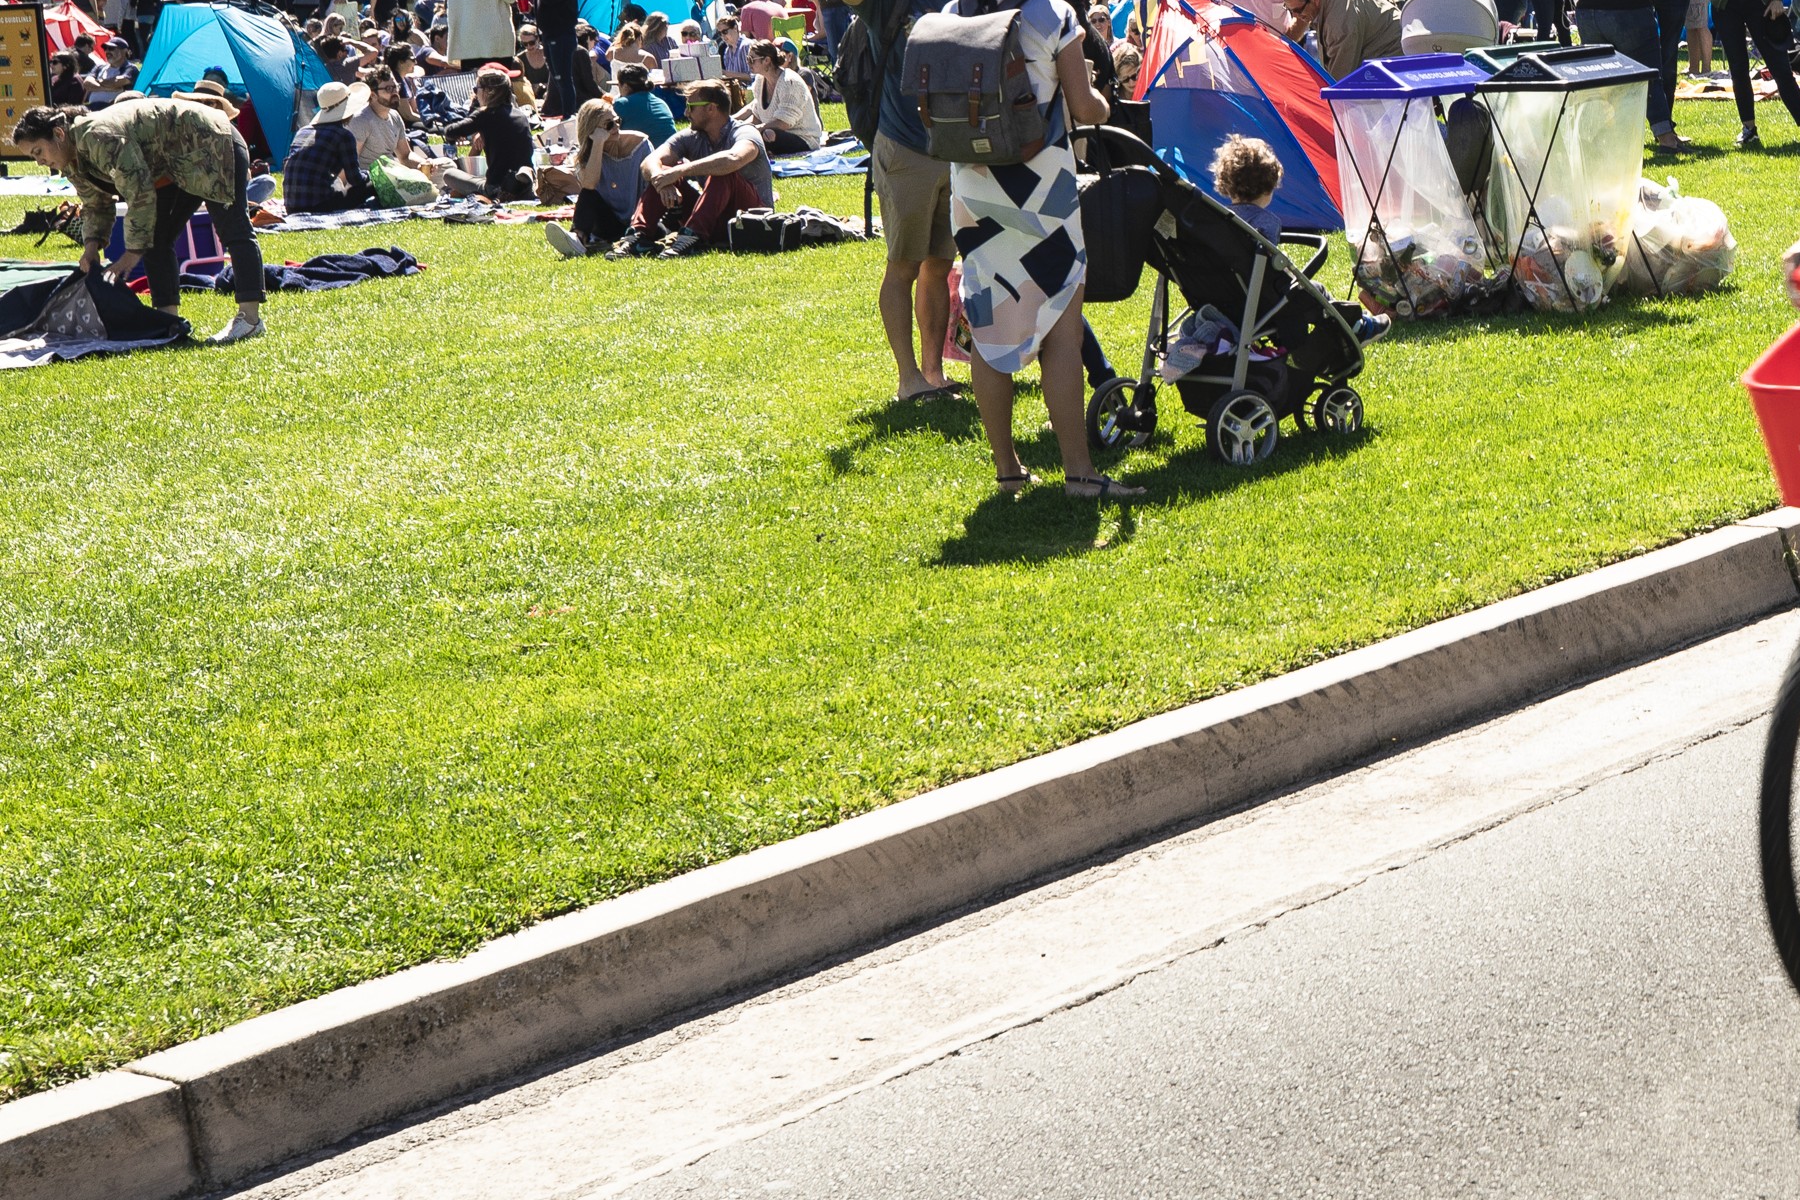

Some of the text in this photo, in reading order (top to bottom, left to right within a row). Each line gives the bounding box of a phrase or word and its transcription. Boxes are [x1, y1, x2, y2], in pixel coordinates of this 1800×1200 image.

[5, 15, 32, 23] GUIDELINES
[1576, 64, 1602, 73] TRASH
[1601, 61, 1623, 70] ONLY
[1418, 71, 1458, 80] RECYCLING
[1455, 69, 1475, 77] ONLY
